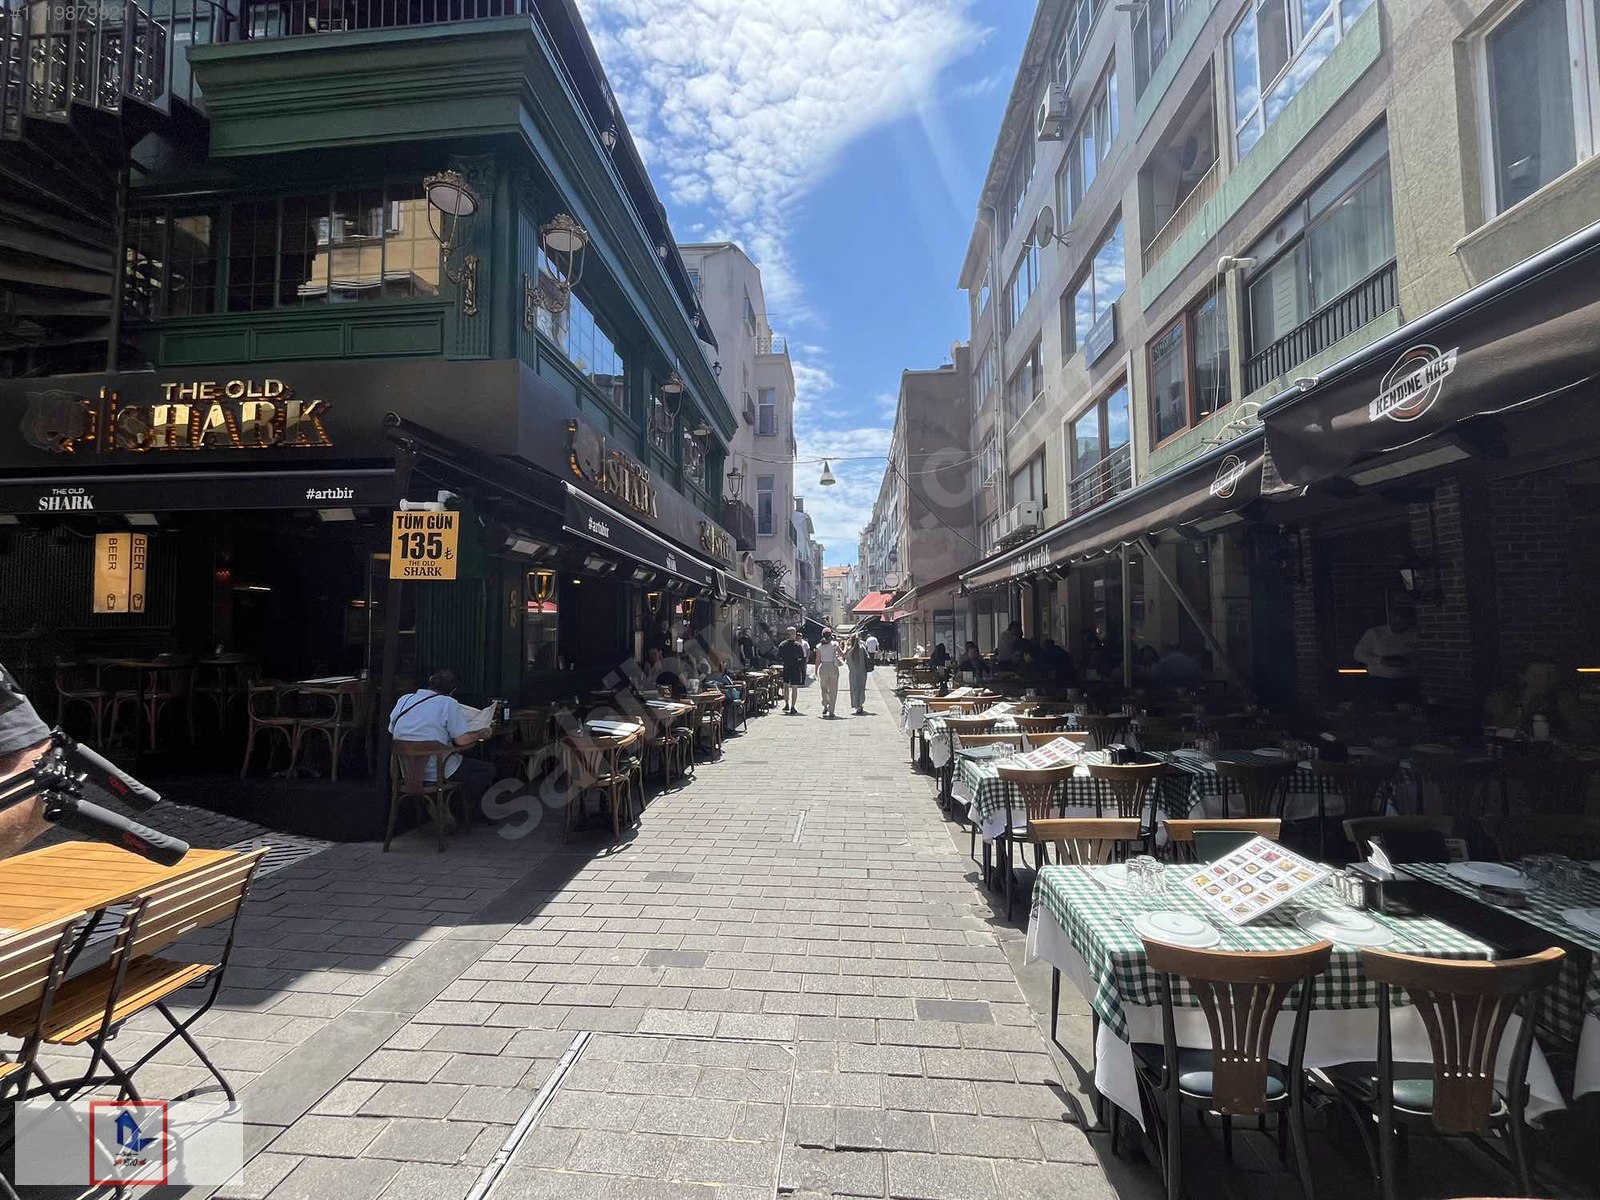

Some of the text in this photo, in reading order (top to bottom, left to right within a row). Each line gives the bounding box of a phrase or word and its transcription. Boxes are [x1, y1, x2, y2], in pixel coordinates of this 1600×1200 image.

[1425, 354, 1450, 384] HAS
[161, 378, 285, 401] THE OLD
[117, 400, 333, 451] SHARK
[68, 487, 85, 495] OLD
[38, 495, 94, 511] SHARK
[396, 513, 453, 529] TÜM GÜN
[108, 537, 118, 570] BEER
[134, 538, 145, 571] BEER
[403, 566, 442, 577] SHARK
